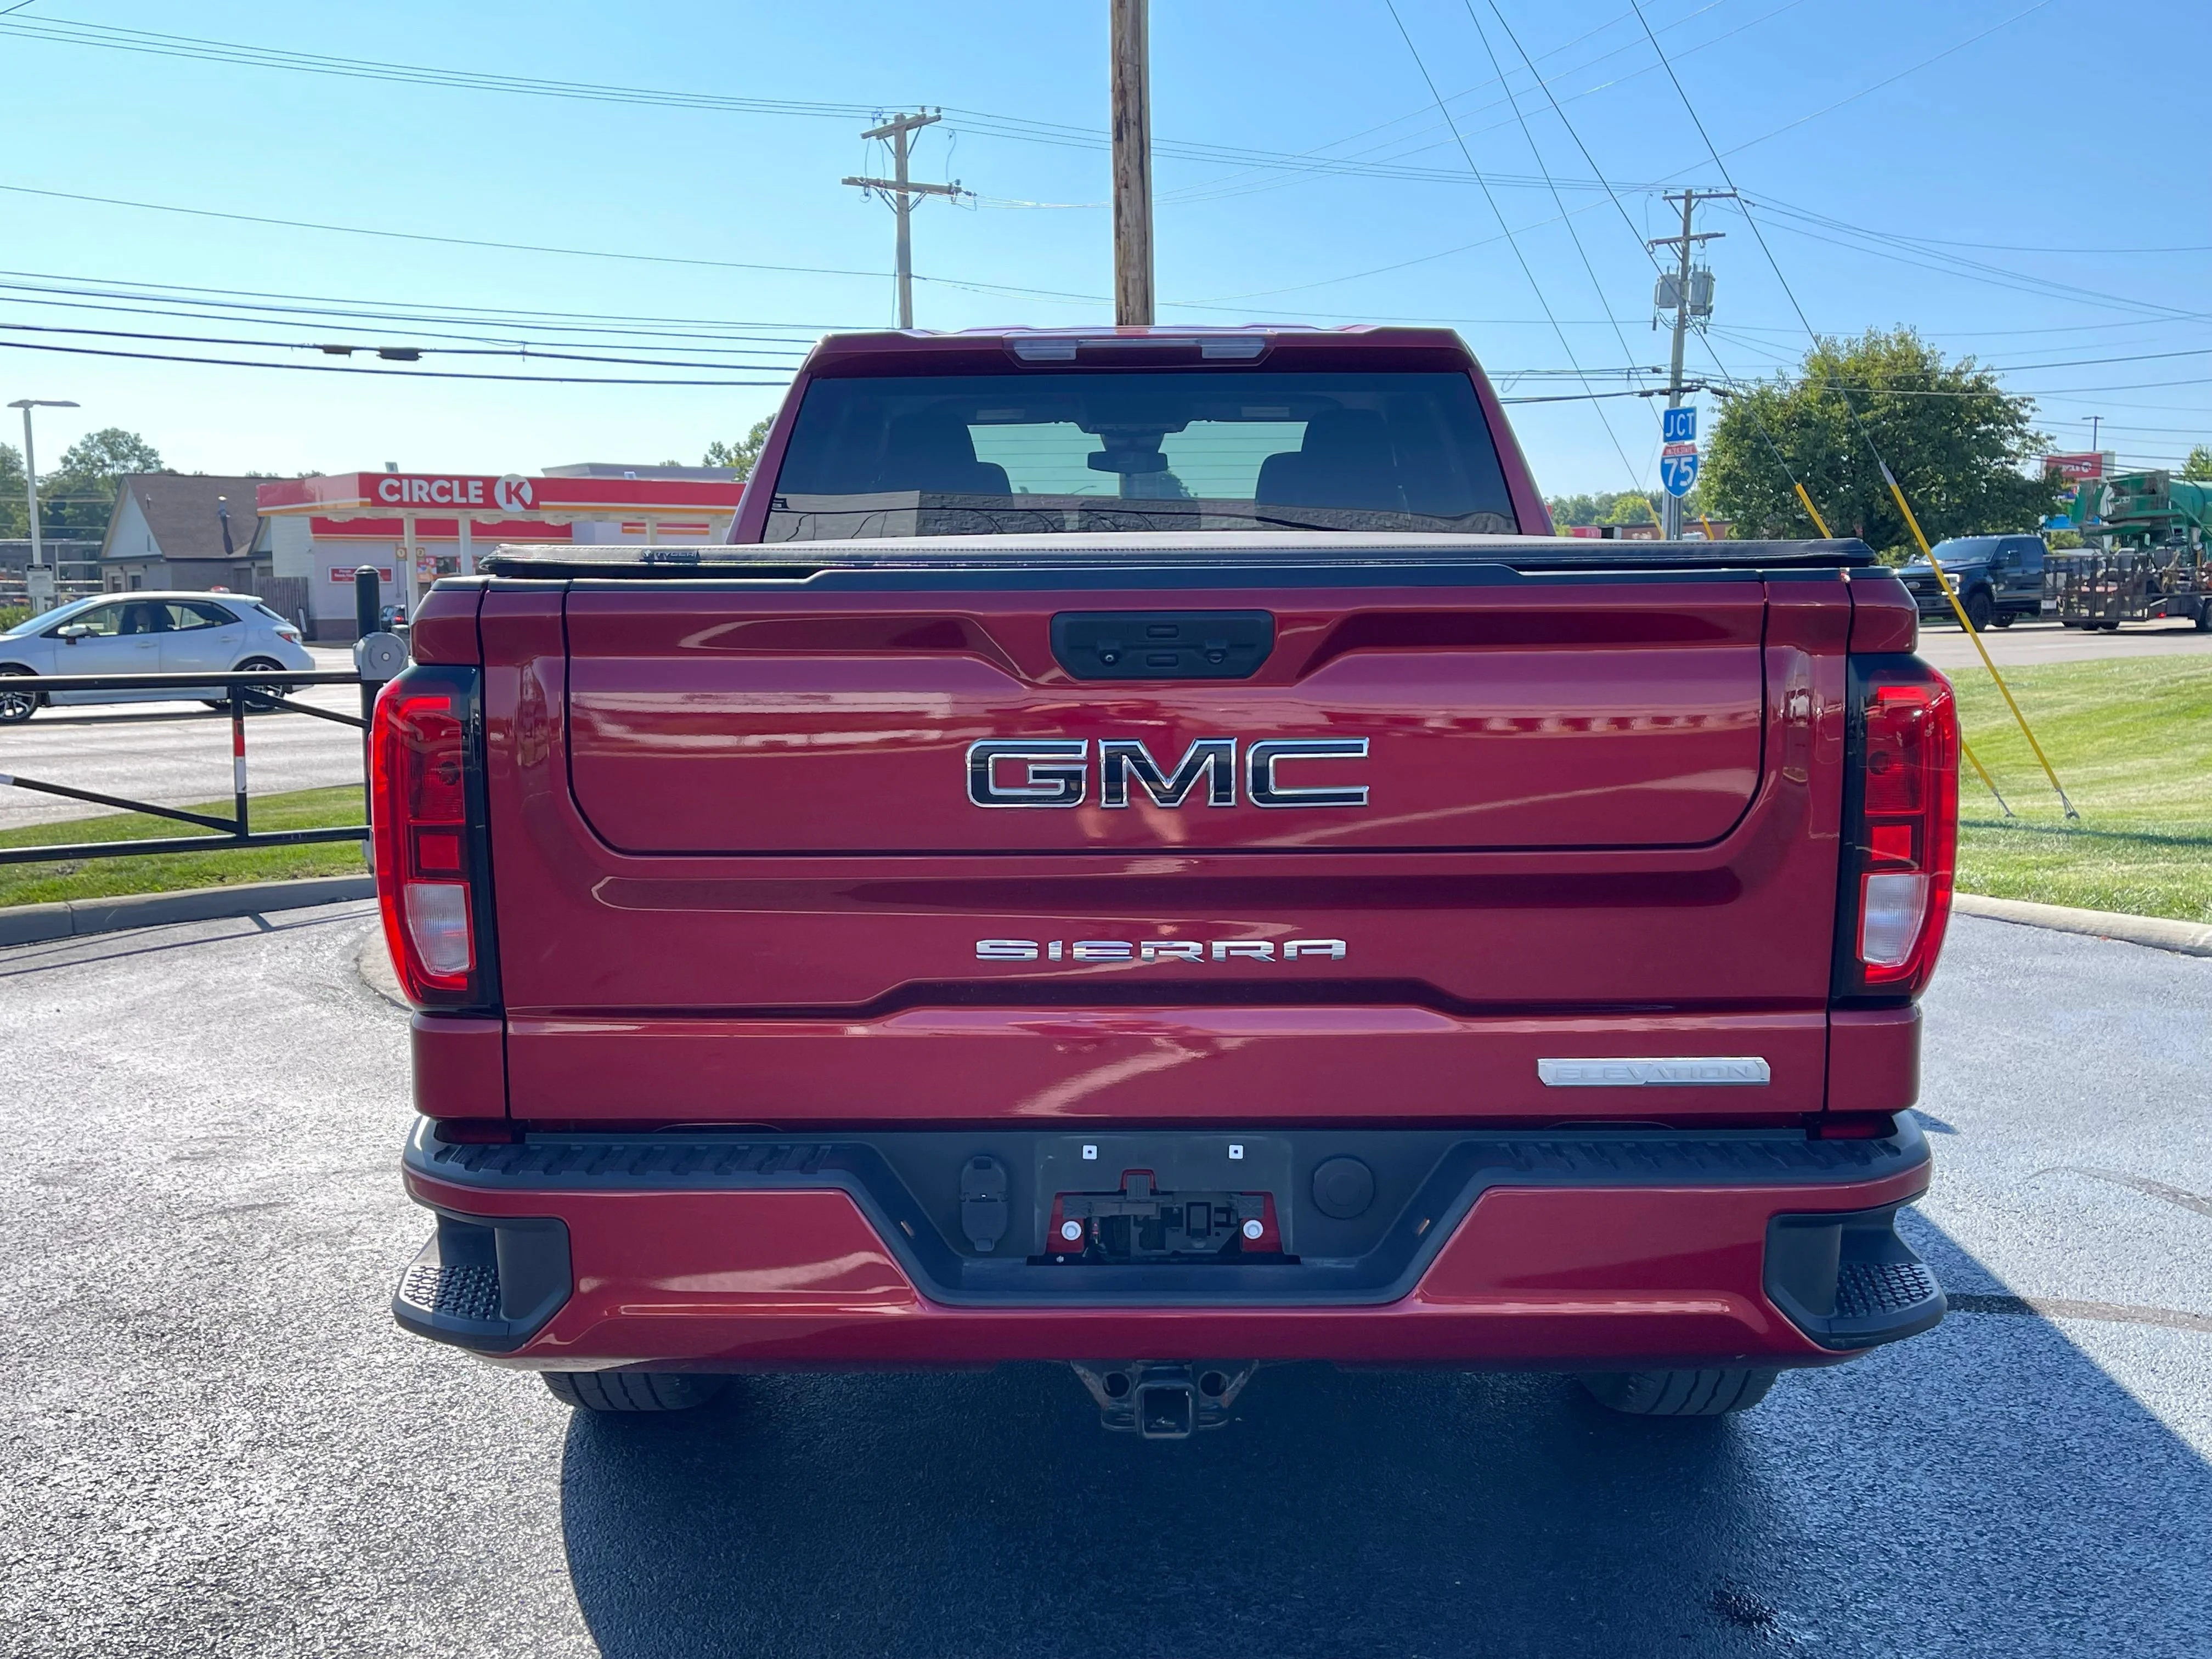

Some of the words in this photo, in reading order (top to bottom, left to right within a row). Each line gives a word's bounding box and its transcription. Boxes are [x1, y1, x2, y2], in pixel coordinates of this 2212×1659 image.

[1666, 413, 1695, 437] JCT
[1664, 456, 1694, 487] 75
[379, 478, 483, 503] CIRCLE
[503, 480, 530, 511] K
[966, 737, 1370, 808] GMC
[976, 939, 1346, 963] SIERRA
[1556, 1065, 1753, 1080] ELEVATION
